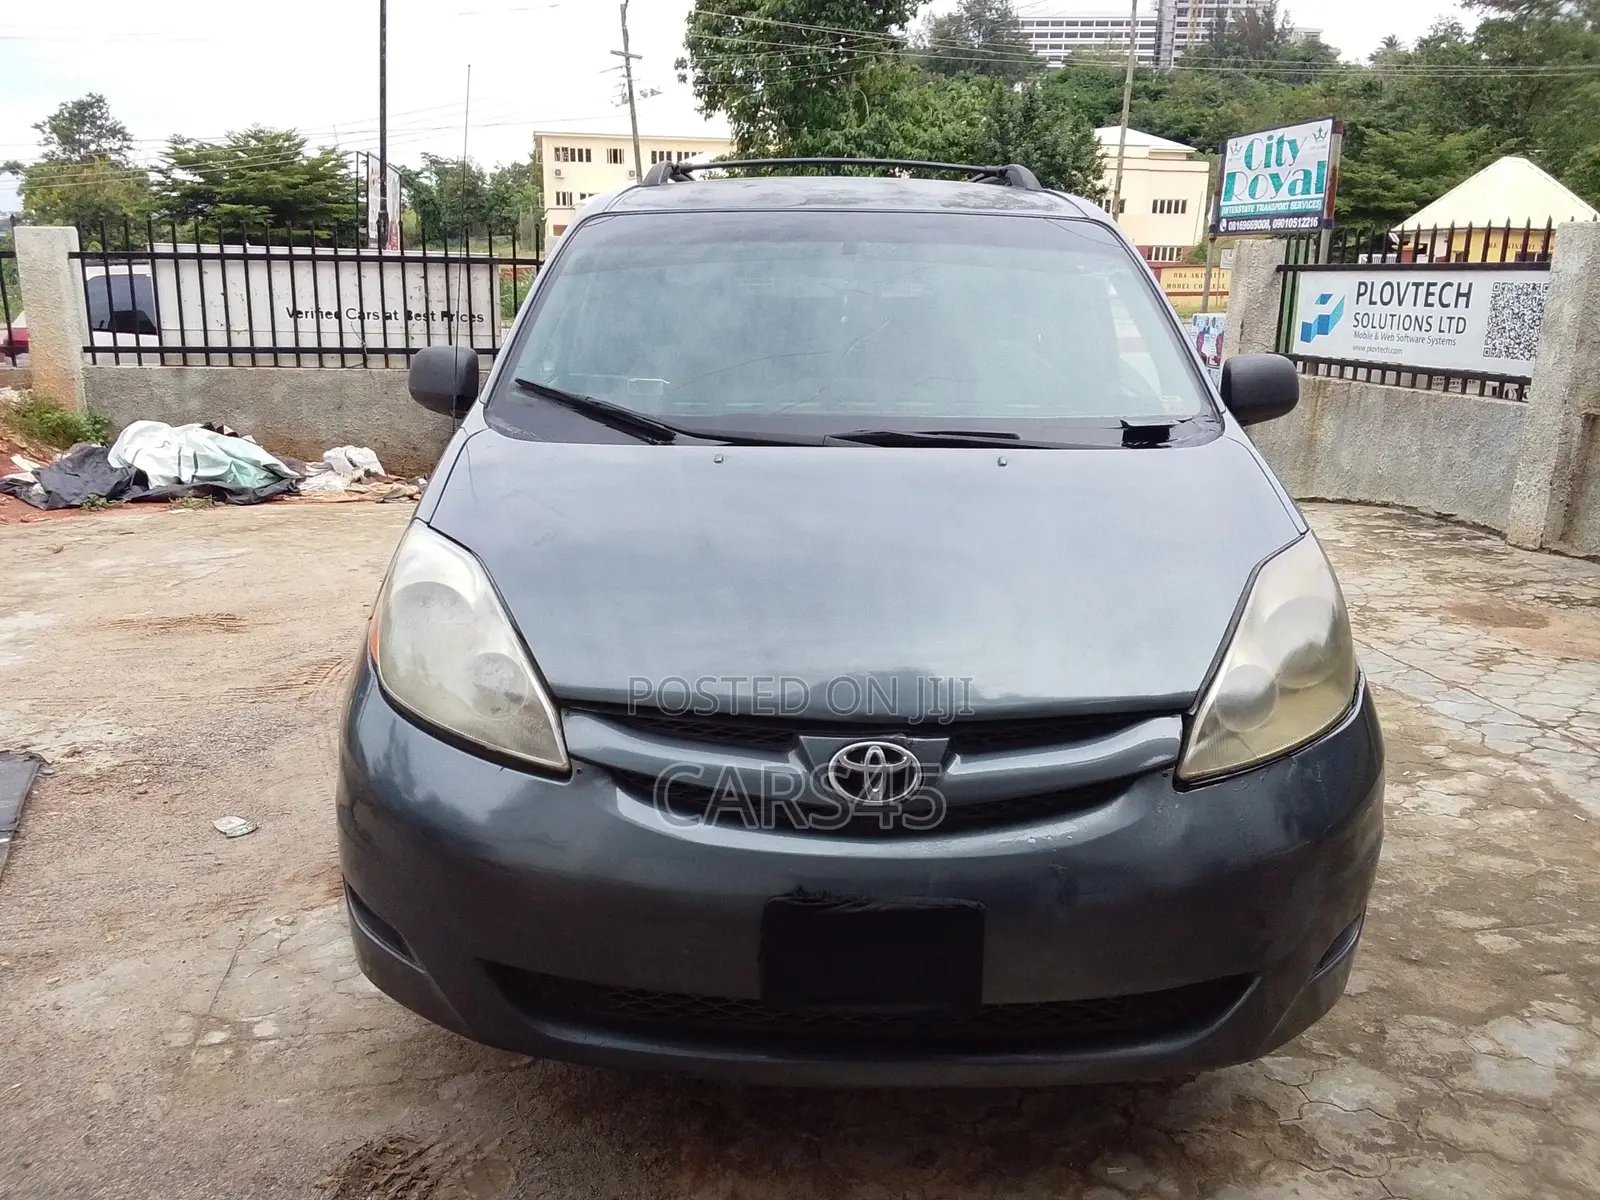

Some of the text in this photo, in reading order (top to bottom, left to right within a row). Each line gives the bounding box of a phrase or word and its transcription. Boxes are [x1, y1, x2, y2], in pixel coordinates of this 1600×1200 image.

[1244, 132, 1307, 171] City
[1223, 160, 1327, 202] Royal
[1256, 202, 1290, 212] TRANSPORT
[1272, 217, 1318, 228] 09010512216
[1355, 281, 1473, 309] PLOVTECH
[345, 307, 380, 320] Cars
[383, 310, 399, 321] at
[1353, 312, 1467, 334] SOLUTIONS LTD
[1353, 330, 1457, 347] Mobile & Web Software Systems
[1352, 345, 1403, 355] www.plovtech.com
